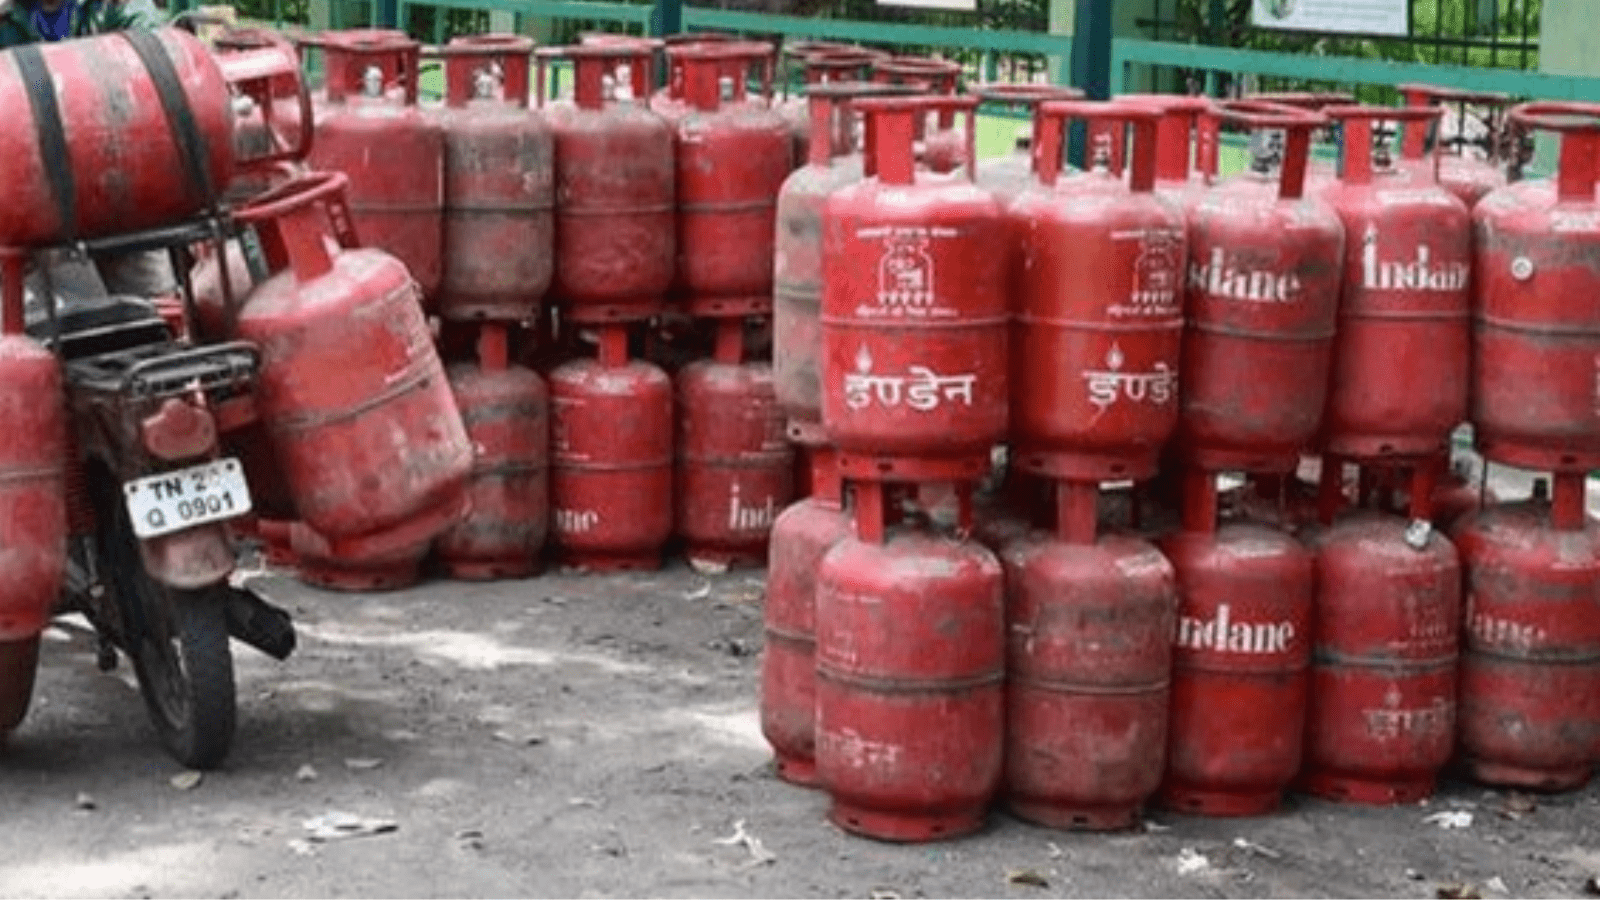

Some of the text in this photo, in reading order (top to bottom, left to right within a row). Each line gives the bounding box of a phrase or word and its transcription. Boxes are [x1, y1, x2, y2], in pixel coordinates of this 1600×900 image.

[1080, 360, 1178, 405] इण्डे
[147, 467, 219, 501] TN 2
[146, 490, 235, 529] Q 0901
